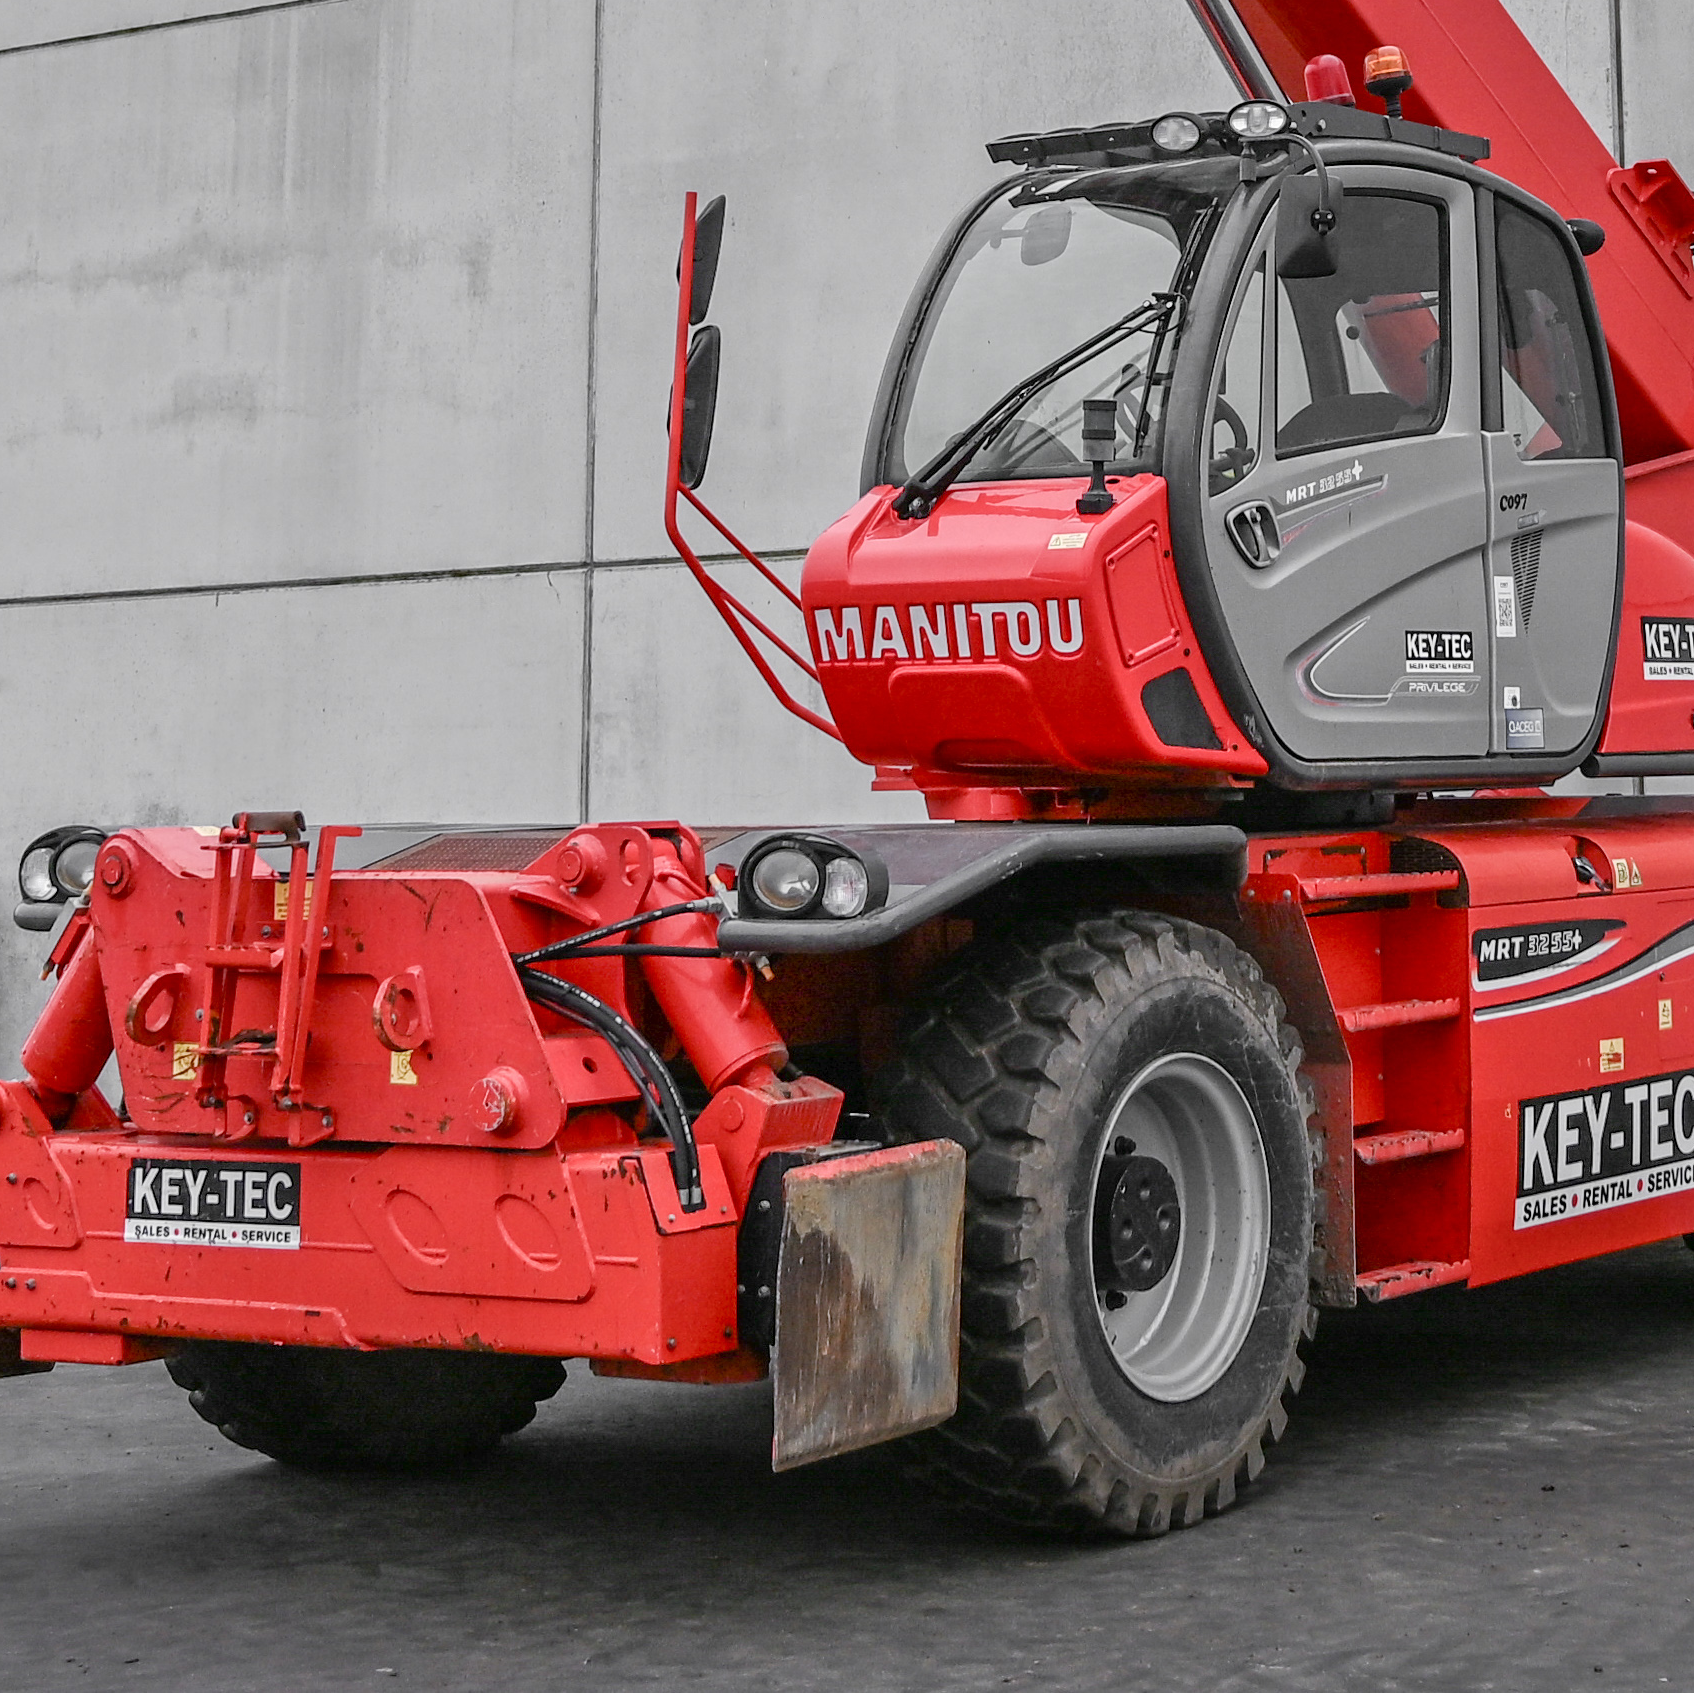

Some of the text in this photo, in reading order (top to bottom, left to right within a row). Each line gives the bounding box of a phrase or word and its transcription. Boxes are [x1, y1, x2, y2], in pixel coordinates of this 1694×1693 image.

[1286, 482, 1316, 504] MRT
[1500, 493, 1527, 511] C097
[814, 599, 1083, 661] MANITOU
[1407, 633, 1471, 658] KEY-TEC
[1409, 682, 1466, 692] PRIVILEGE
[1480, 929, 1582, 962] MRT 3255+
[133, 1167, 293, 1220] KEY-TEC
[1523, 1194, 1567, 1222] SALES
[1583, 1179, 1633, 1208] RENTAL
[135, 1225, 291, 1242] SALES RENTAL SERVICE
